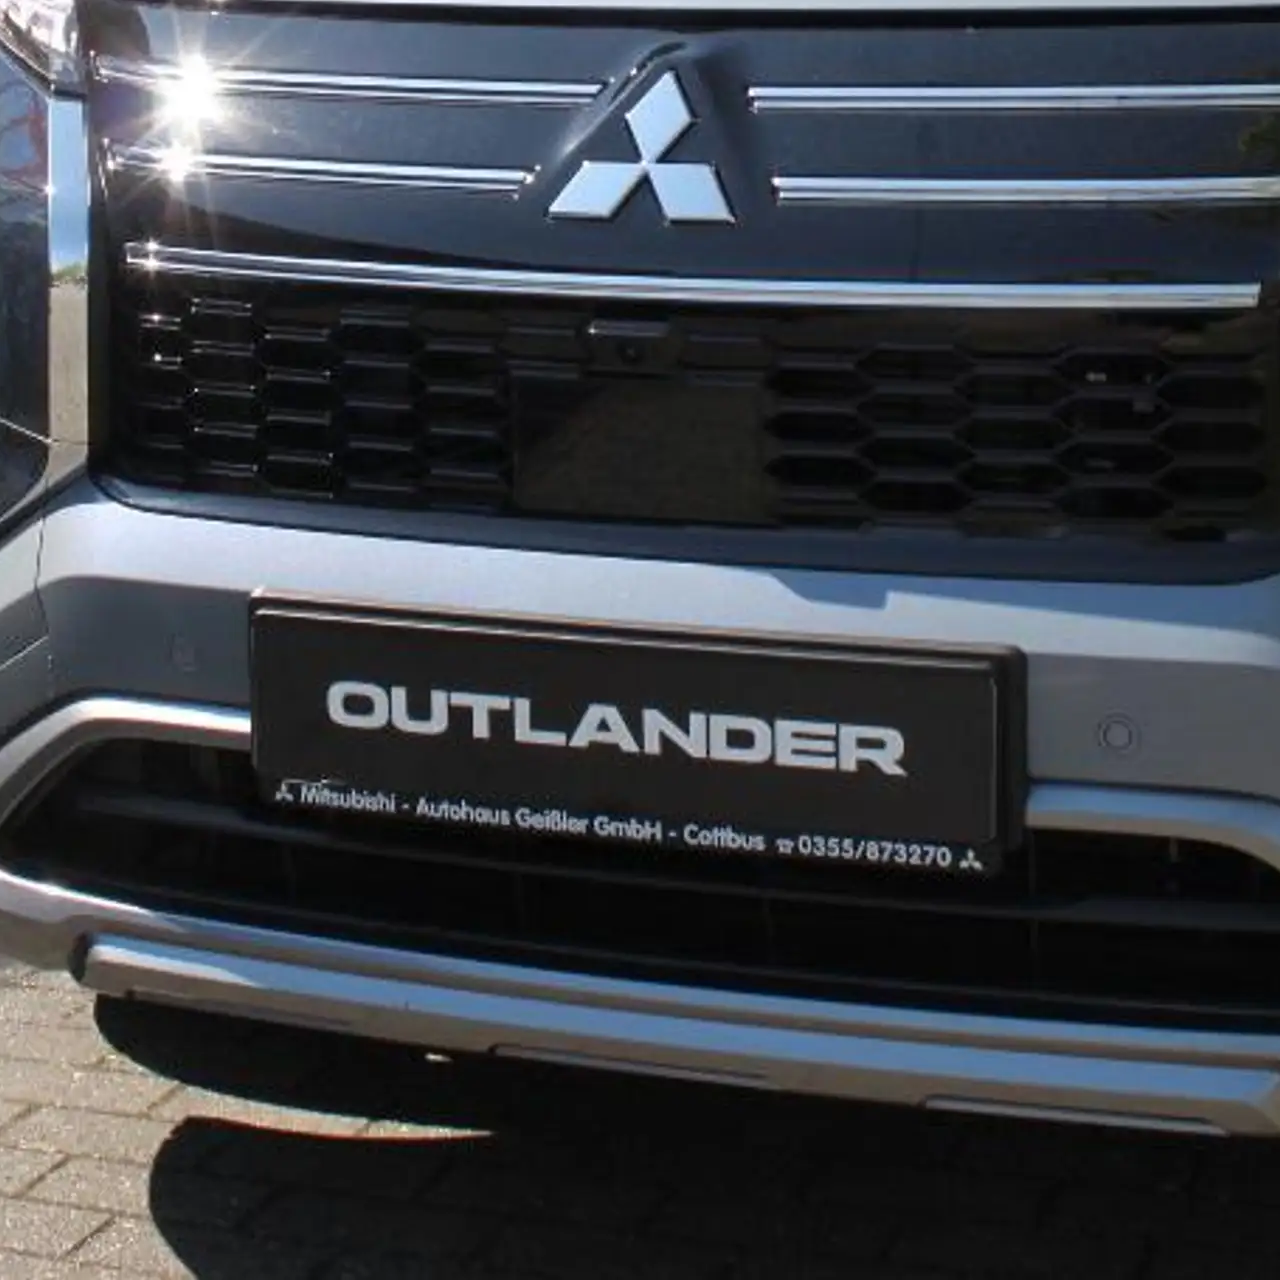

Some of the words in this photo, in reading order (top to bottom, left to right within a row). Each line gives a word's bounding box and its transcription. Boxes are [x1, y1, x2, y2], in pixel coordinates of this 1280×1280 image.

[325, 679, 909, 777] OUTLANDER
[299, 783, 397, 814] Mitsubishi
[416, 796, 511, 826] Autohaus
[515, 807, 589, 836] Geißler
[593, 815, 662, 843] GmbH
[683, 822, 767, 853] Cottbus
[798, 834, 953, 868] 0355/873270
